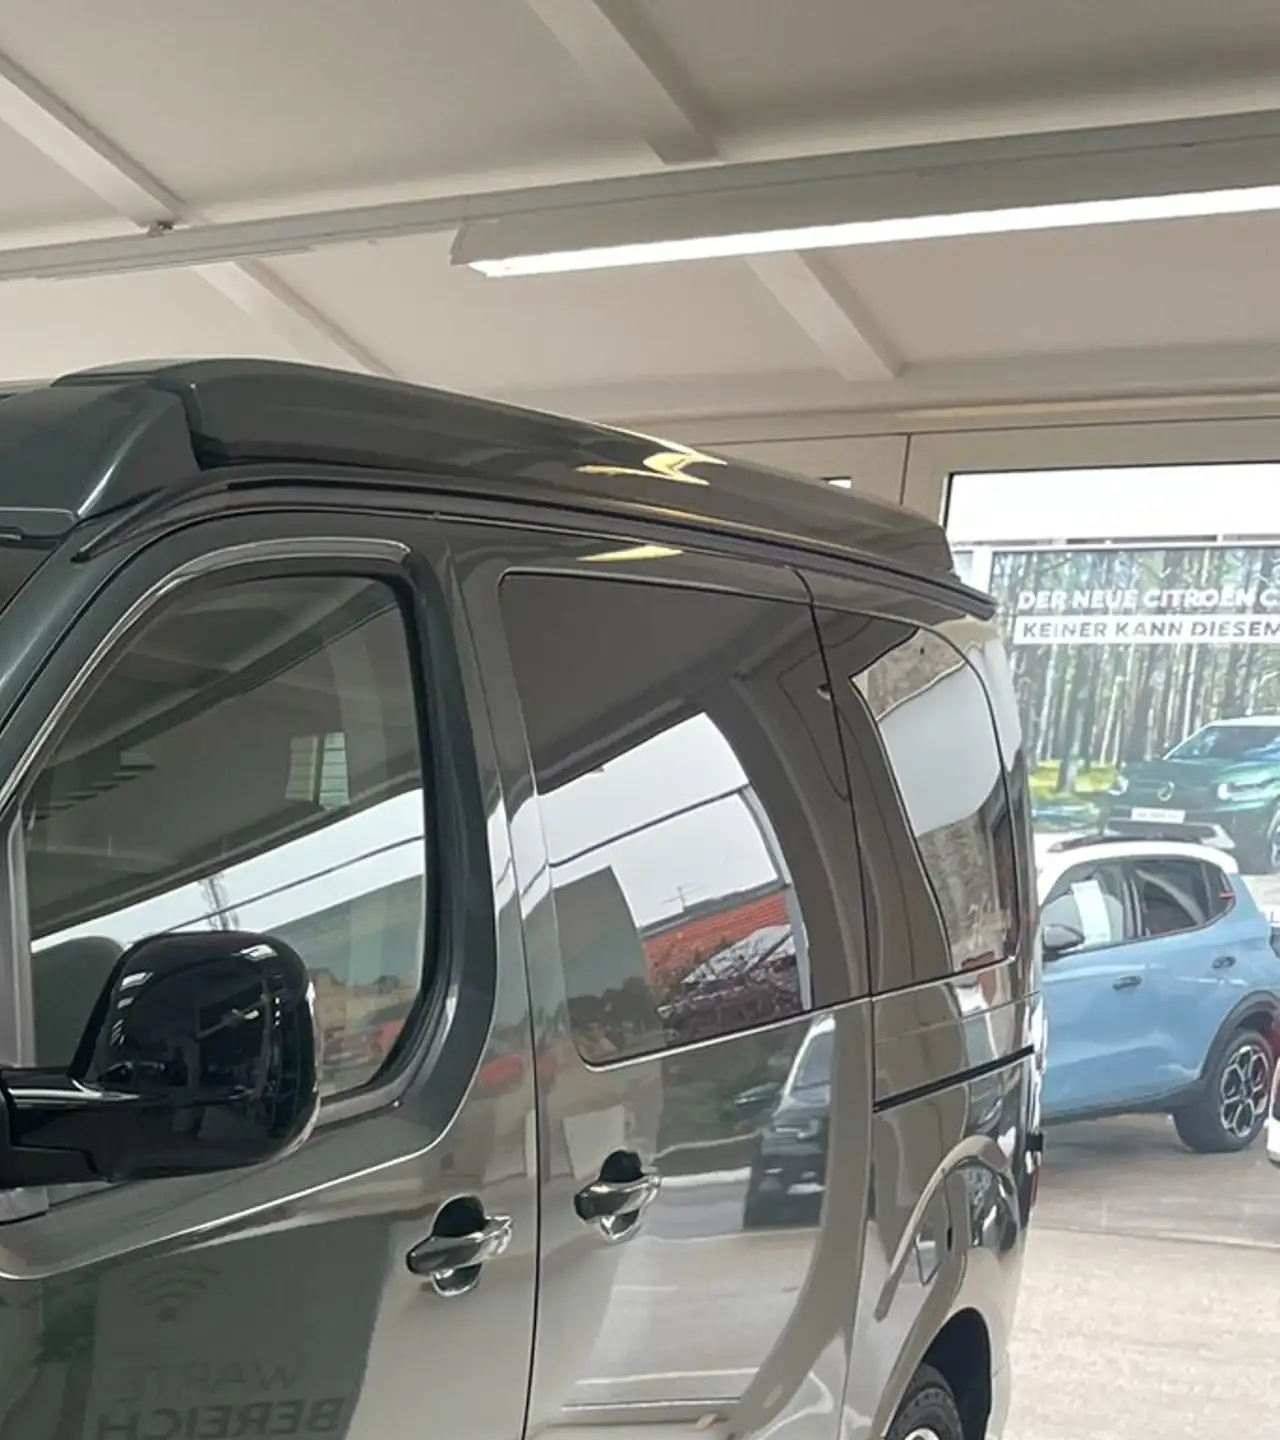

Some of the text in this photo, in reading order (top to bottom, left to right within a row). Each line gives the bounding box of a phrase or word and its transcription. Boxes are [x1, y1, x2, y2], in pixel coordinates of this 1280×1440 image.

[1016, 590, 1066, 610] DER
[1071, 590, 1138, 609] NEUE
[1023, 621, 1280, 638] KEINER KANN DIESEM
